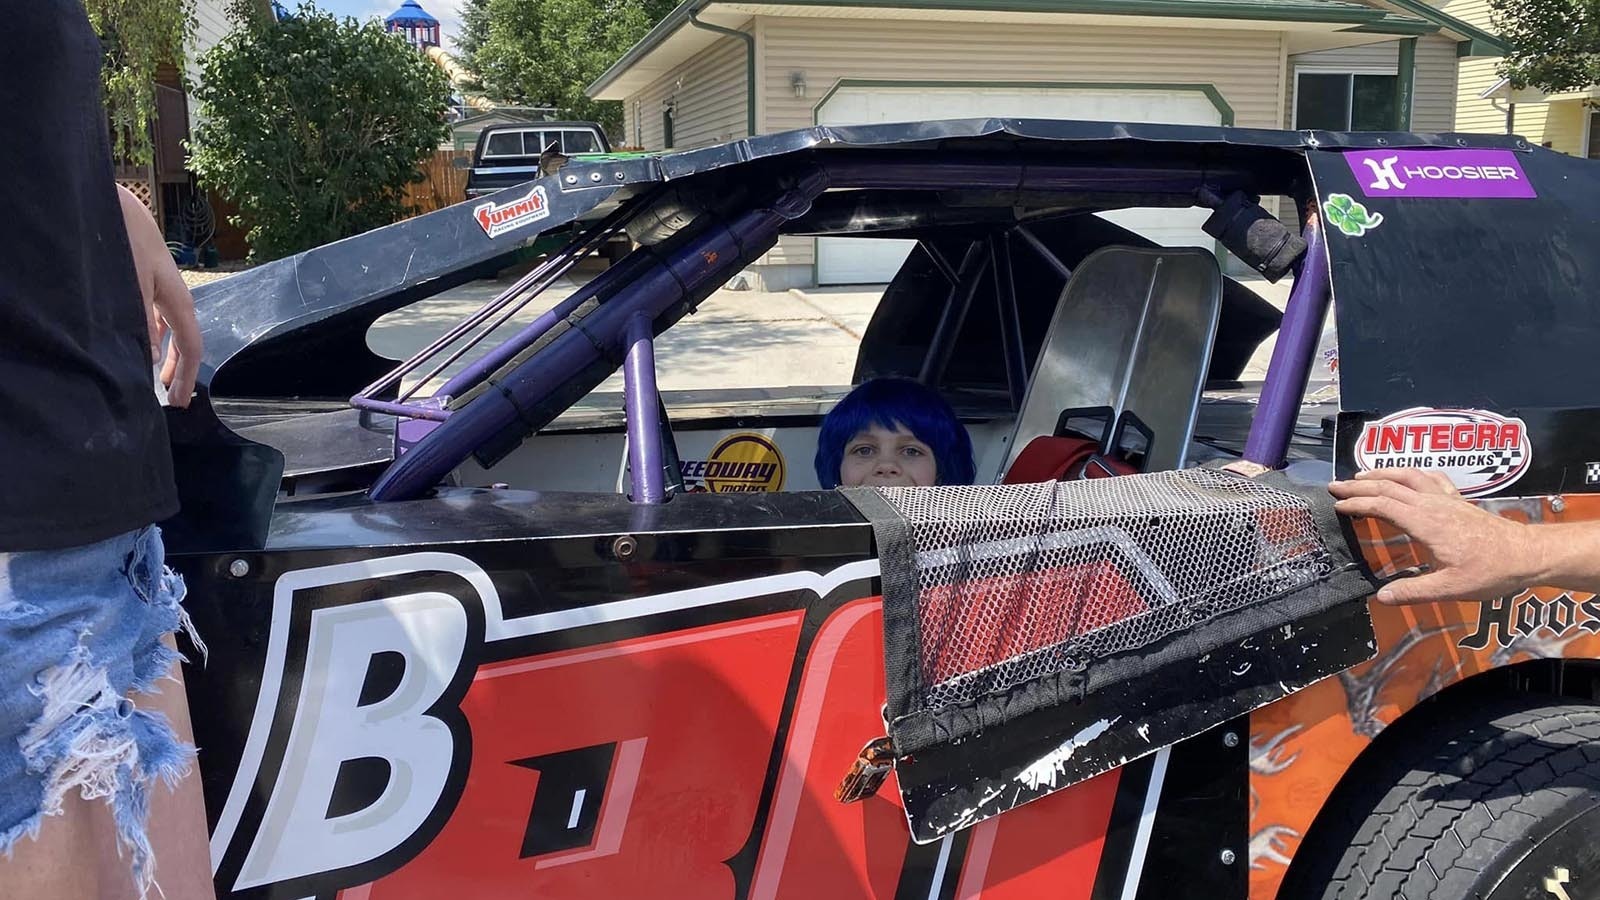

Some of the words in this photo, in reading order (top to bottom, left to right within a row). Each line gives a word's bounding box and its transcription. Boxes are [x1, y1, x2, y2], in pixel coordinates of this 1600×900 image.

[1403, 166, 1519, 180] HOOSIER
[1364, 424, 1521, 454] INTEGRA
[1374, 456, 1433, 470] RACING
[1438, 455, 1495, 467] SHOCKS
